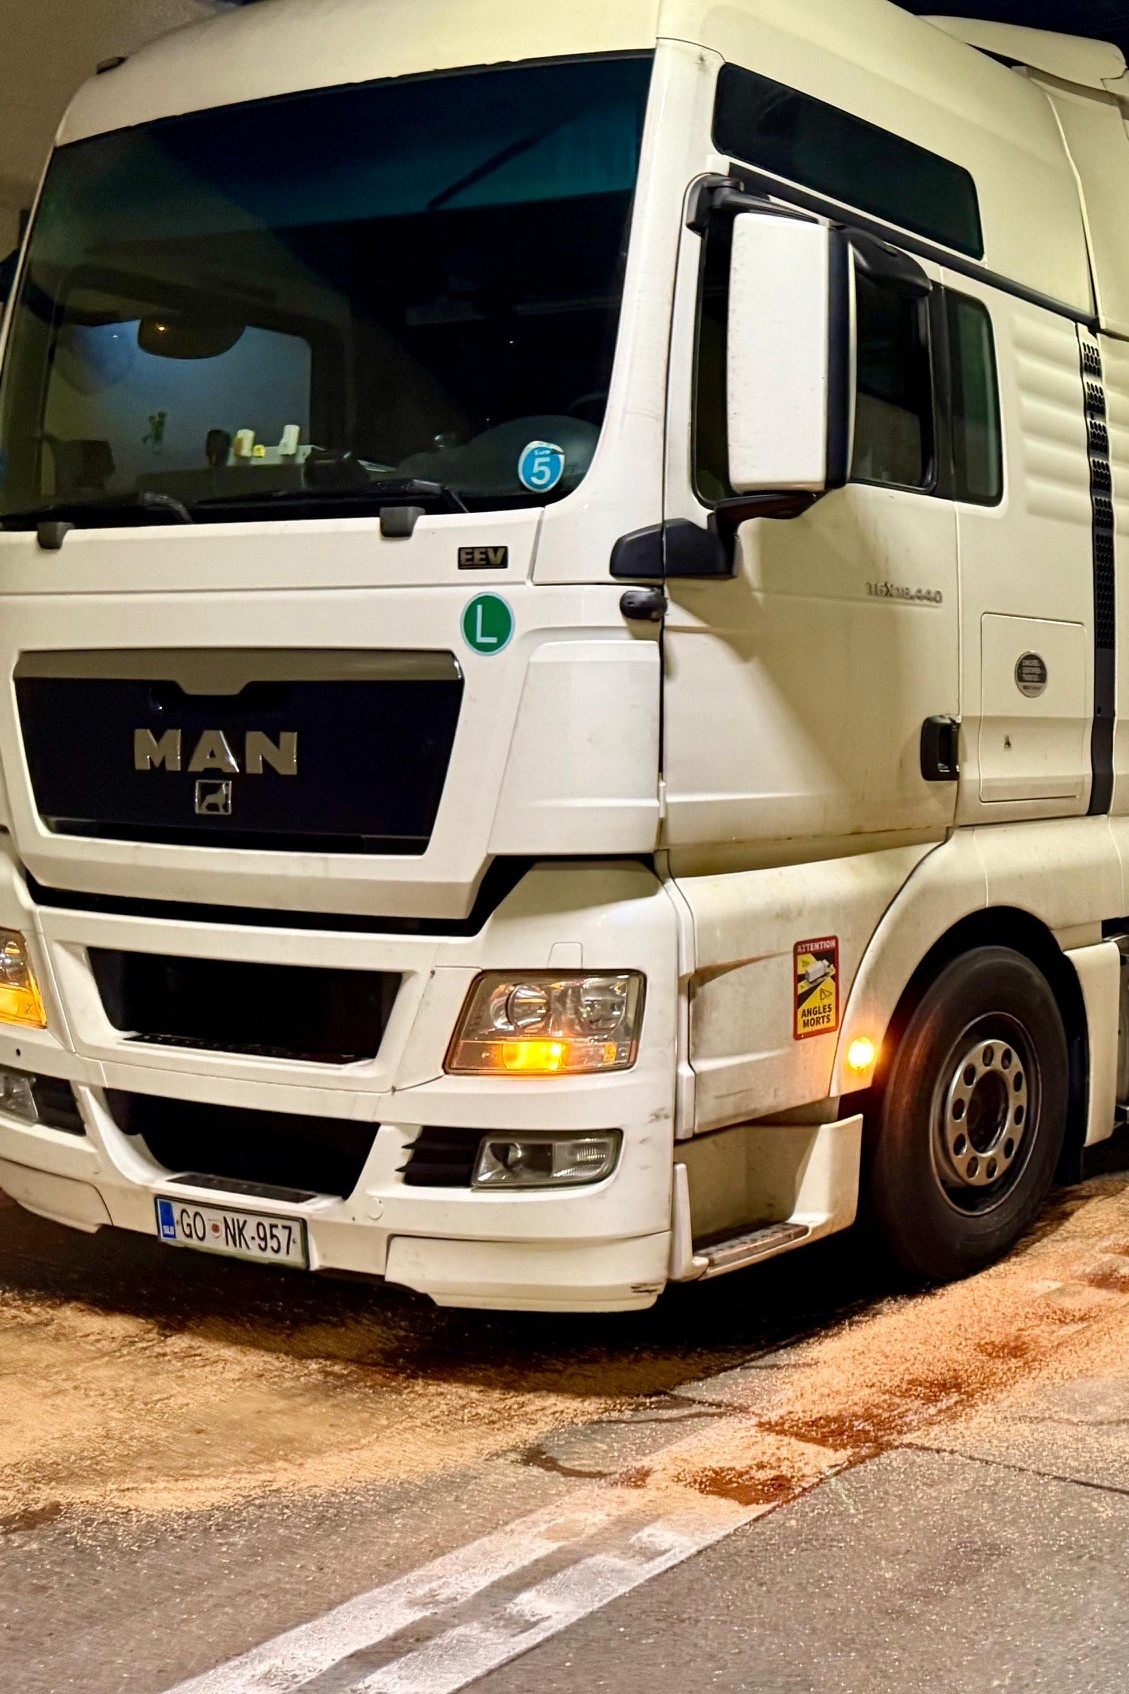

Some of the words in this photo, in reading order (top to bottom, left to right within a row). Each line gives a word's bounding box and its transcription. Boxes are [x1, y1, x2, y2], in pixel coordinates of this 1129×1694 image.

[530, 457, 551, 485] 5
[460, 548, 505, 565] EEV
[476, 604, 498, 643] L
[134, 728, 298, 776] MAN
[797, 939, 836, 953] ATTENTION
[801, 1003, 832, 1018] ANGLES
[803, 1014, 831, 1028] MORTS
[180, 1208, 206, 1242] GO
[223, 1216, 293, 1256] NK-957
